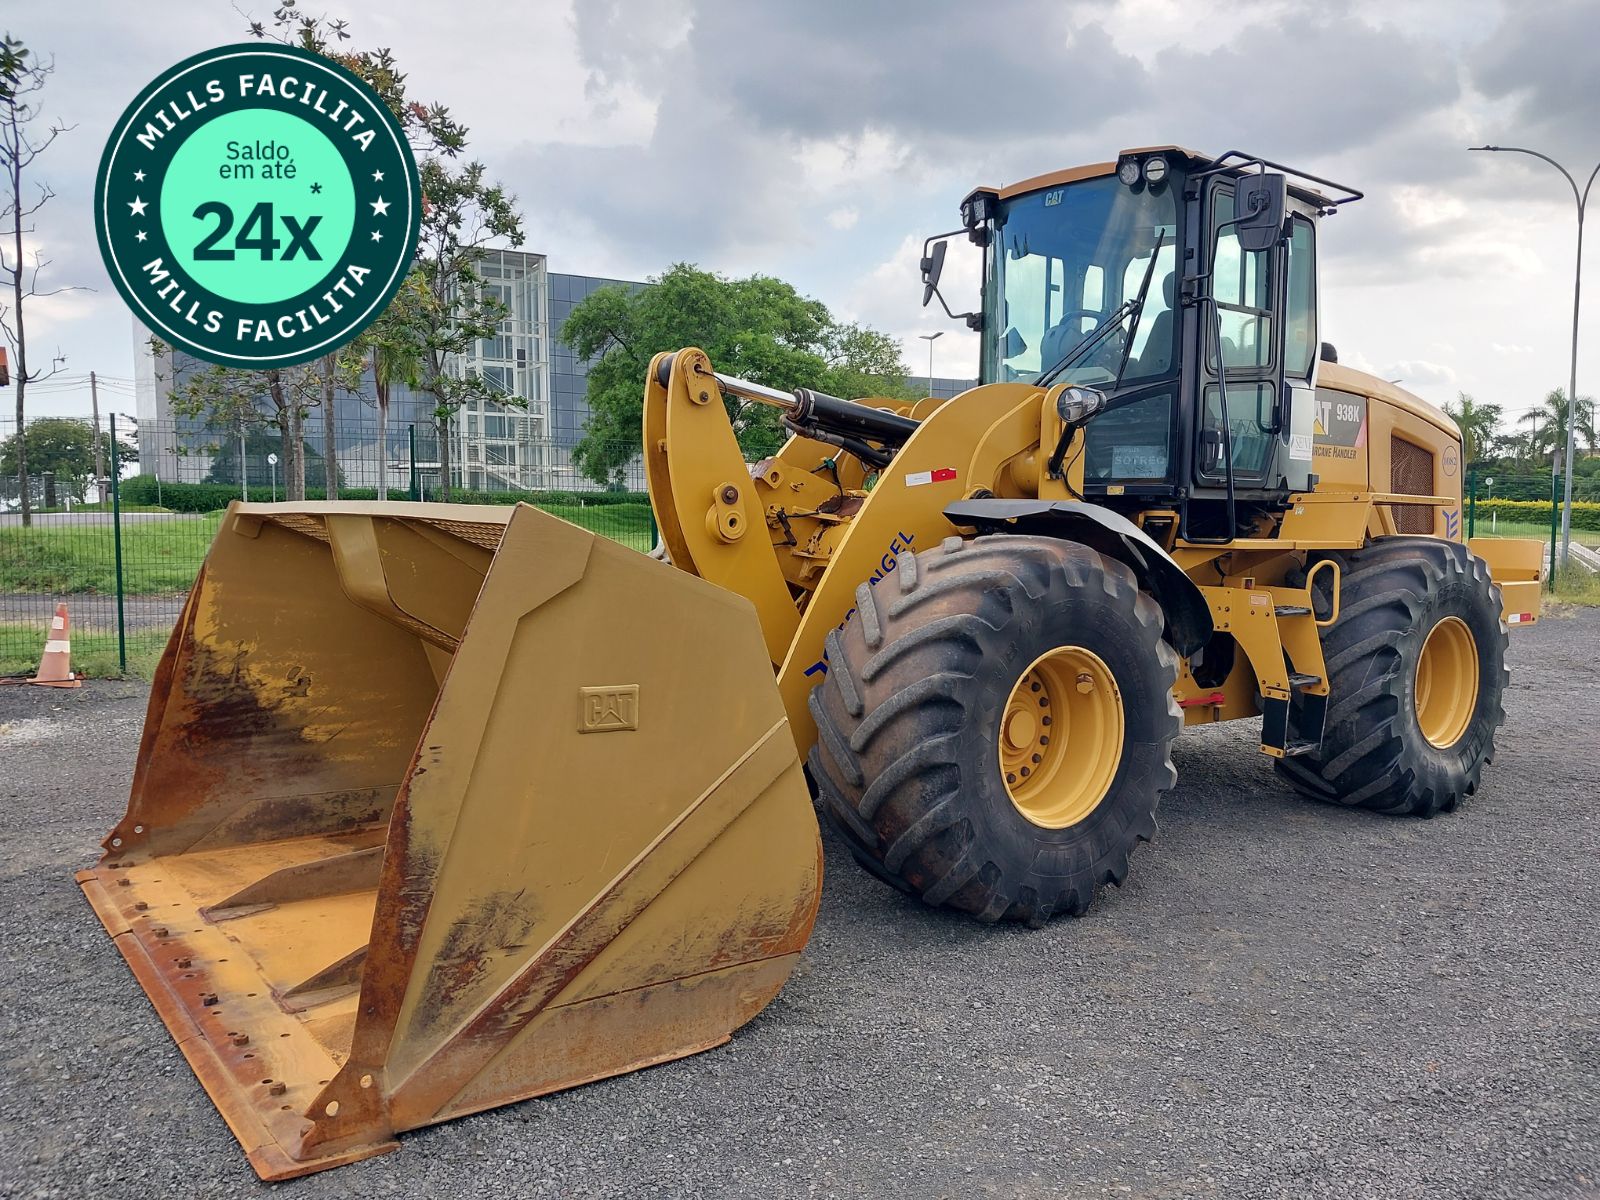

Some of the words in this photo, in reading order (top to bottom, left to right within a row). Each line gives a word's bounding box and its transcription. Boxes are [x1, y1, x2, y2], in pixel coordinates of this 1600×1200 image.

[1045, 190, 1065, 207] CAT
[1313, 400, 1332, 435] AT
[1336, 403, 1361, 423] 938K
[584, 692, 633, 728] CAT
